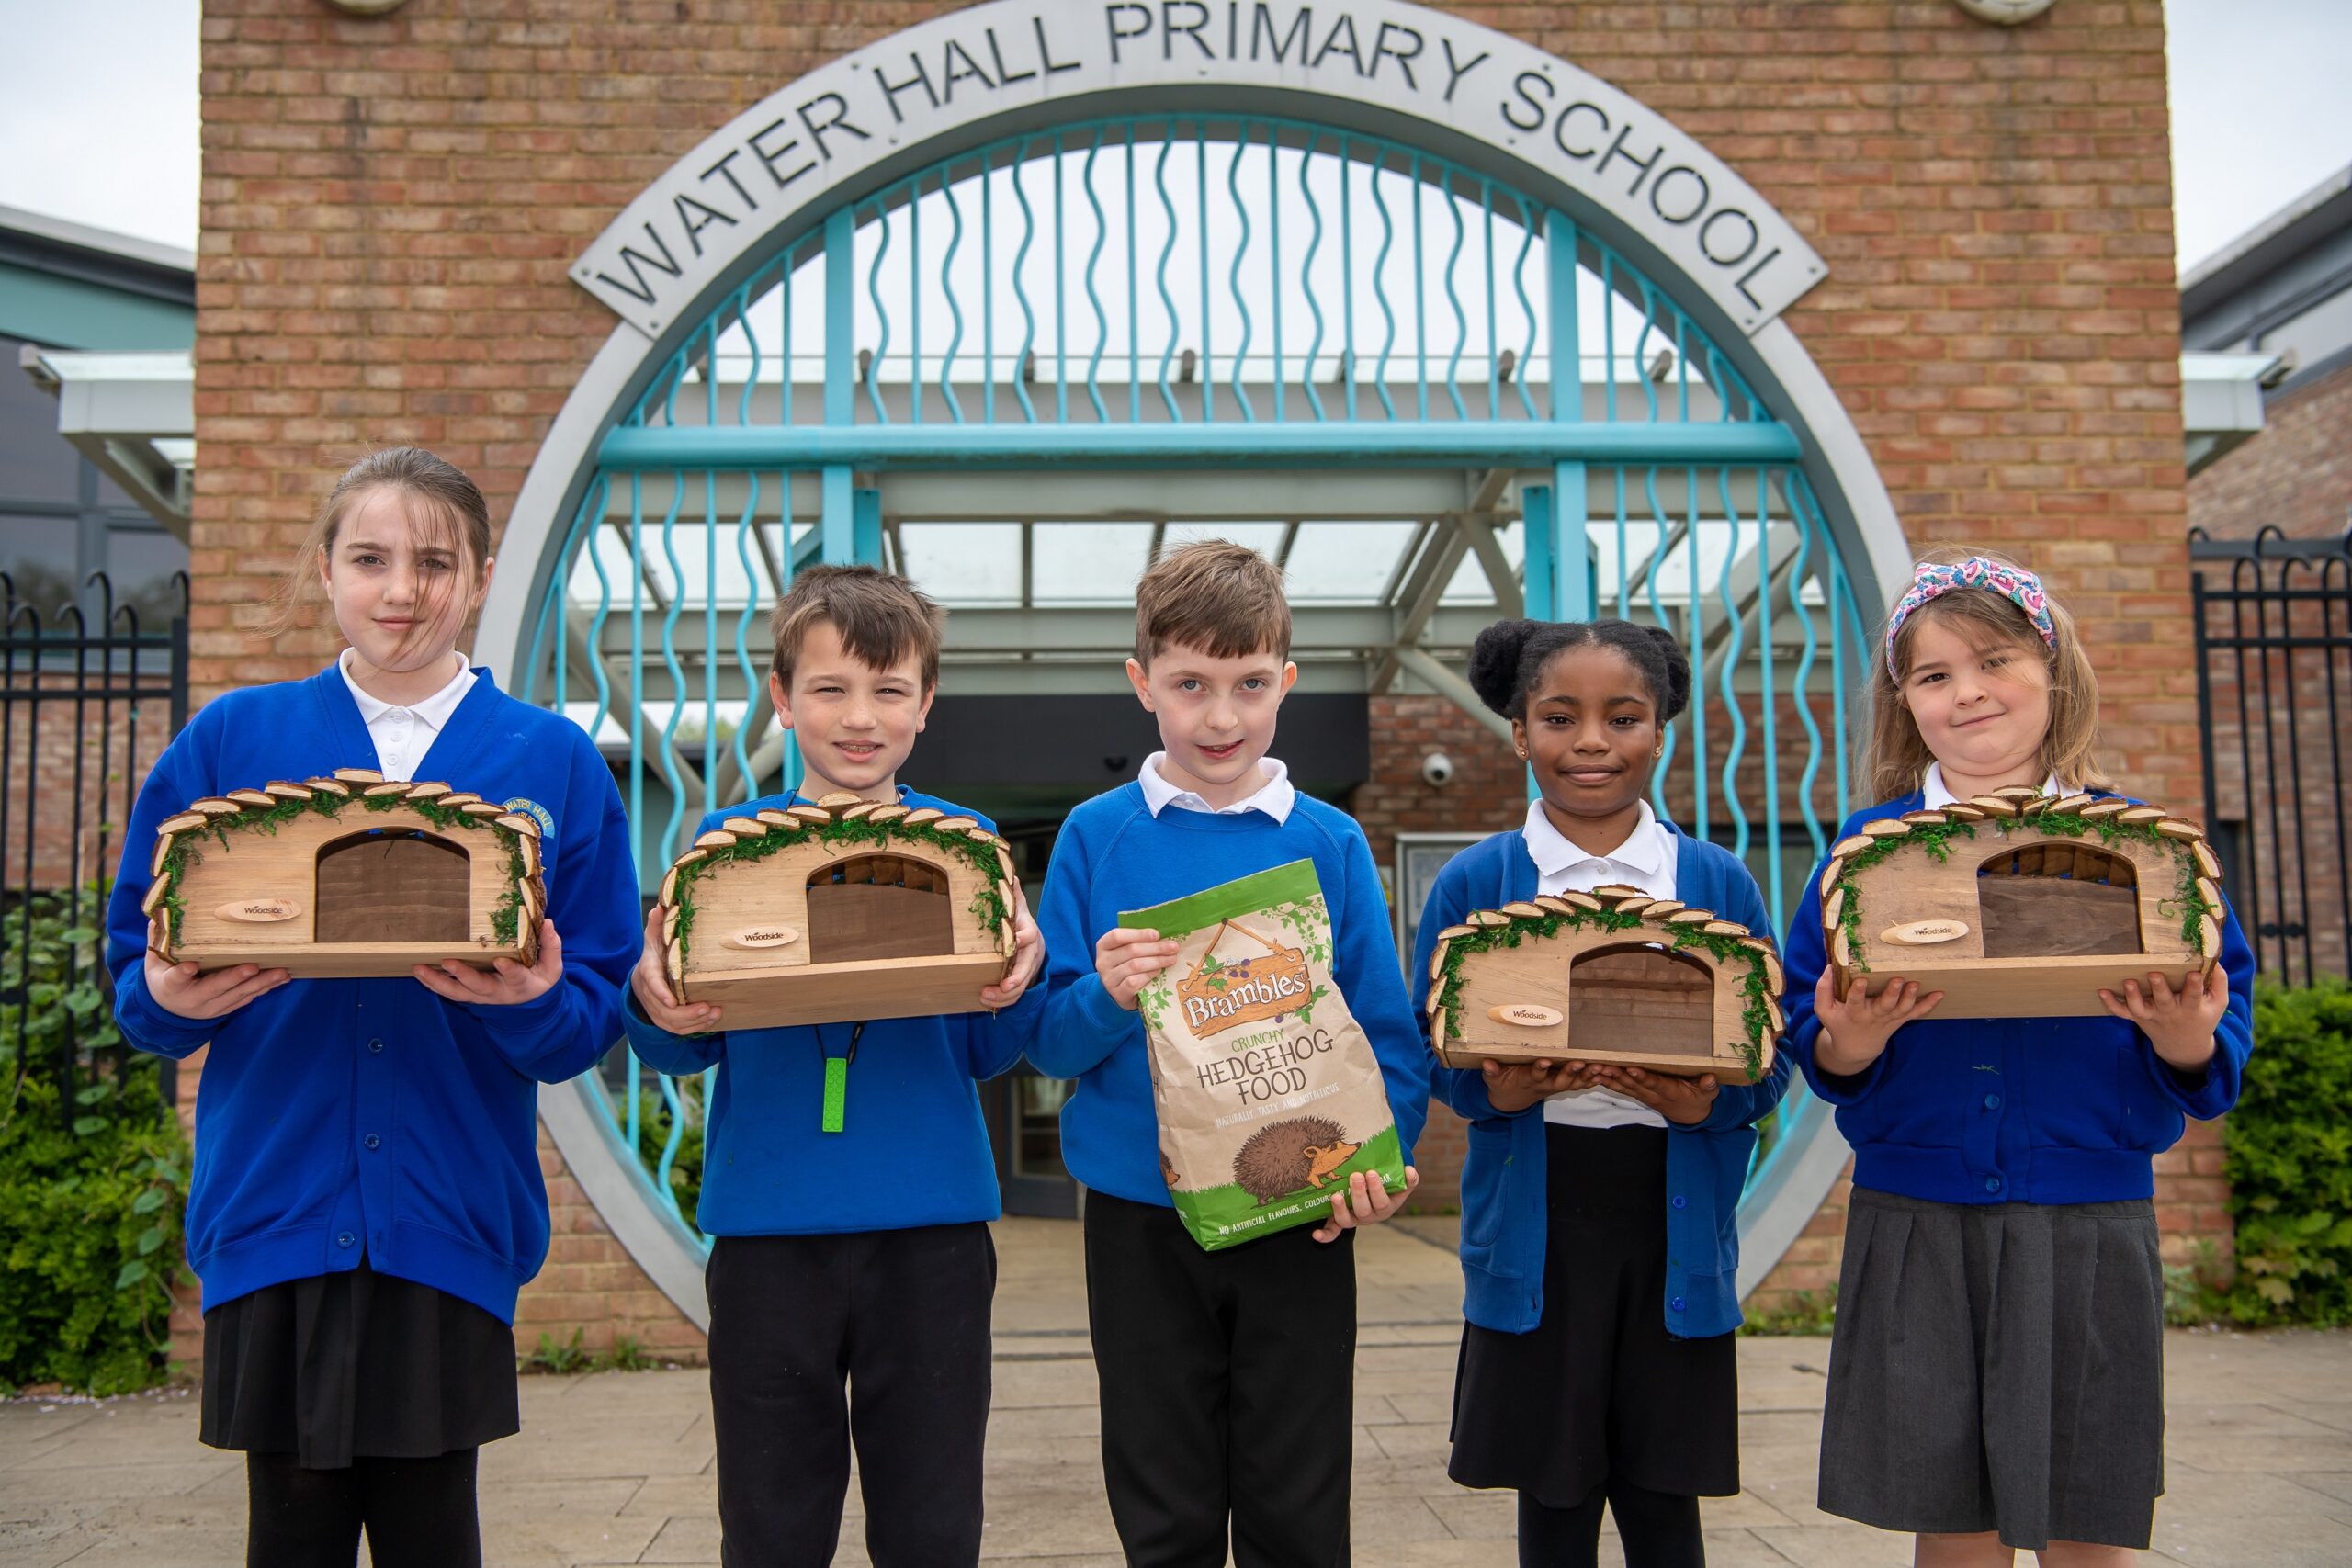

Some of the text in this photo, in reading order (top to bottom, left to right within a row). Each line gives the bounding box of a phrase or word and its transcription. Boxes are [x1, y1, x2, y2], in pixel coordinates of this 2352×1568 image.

[597, 2, 1782, 311] WATER HALL PRIMARY SCHOOL
[504, 798, 530, 812] WATER
[533, 804, 552, 829] HALL
[244, 906, 283, 914] Woodside
[744, 932, 784, 942] Woodside
[1914, 927, 1952, 936] Woodside
[1184, 972, 1306, 1028] Brambles
[1512, 1010, 1547, 1020] Woodside
[1231, 1028, 1285, 1053] CRUNCHY
[1196, 1028, 1333, 1089] HEDGEHOG
[1236, 1067, 1306, 1105] FOOD
[1215, 1082, 1340, 1128] NATURALLY TASTY AND NUTRITIOUS
[1218, 1225, 1230, 1235] NO
[1232, 1215, 1266, 1232] ARTIFICIAL
